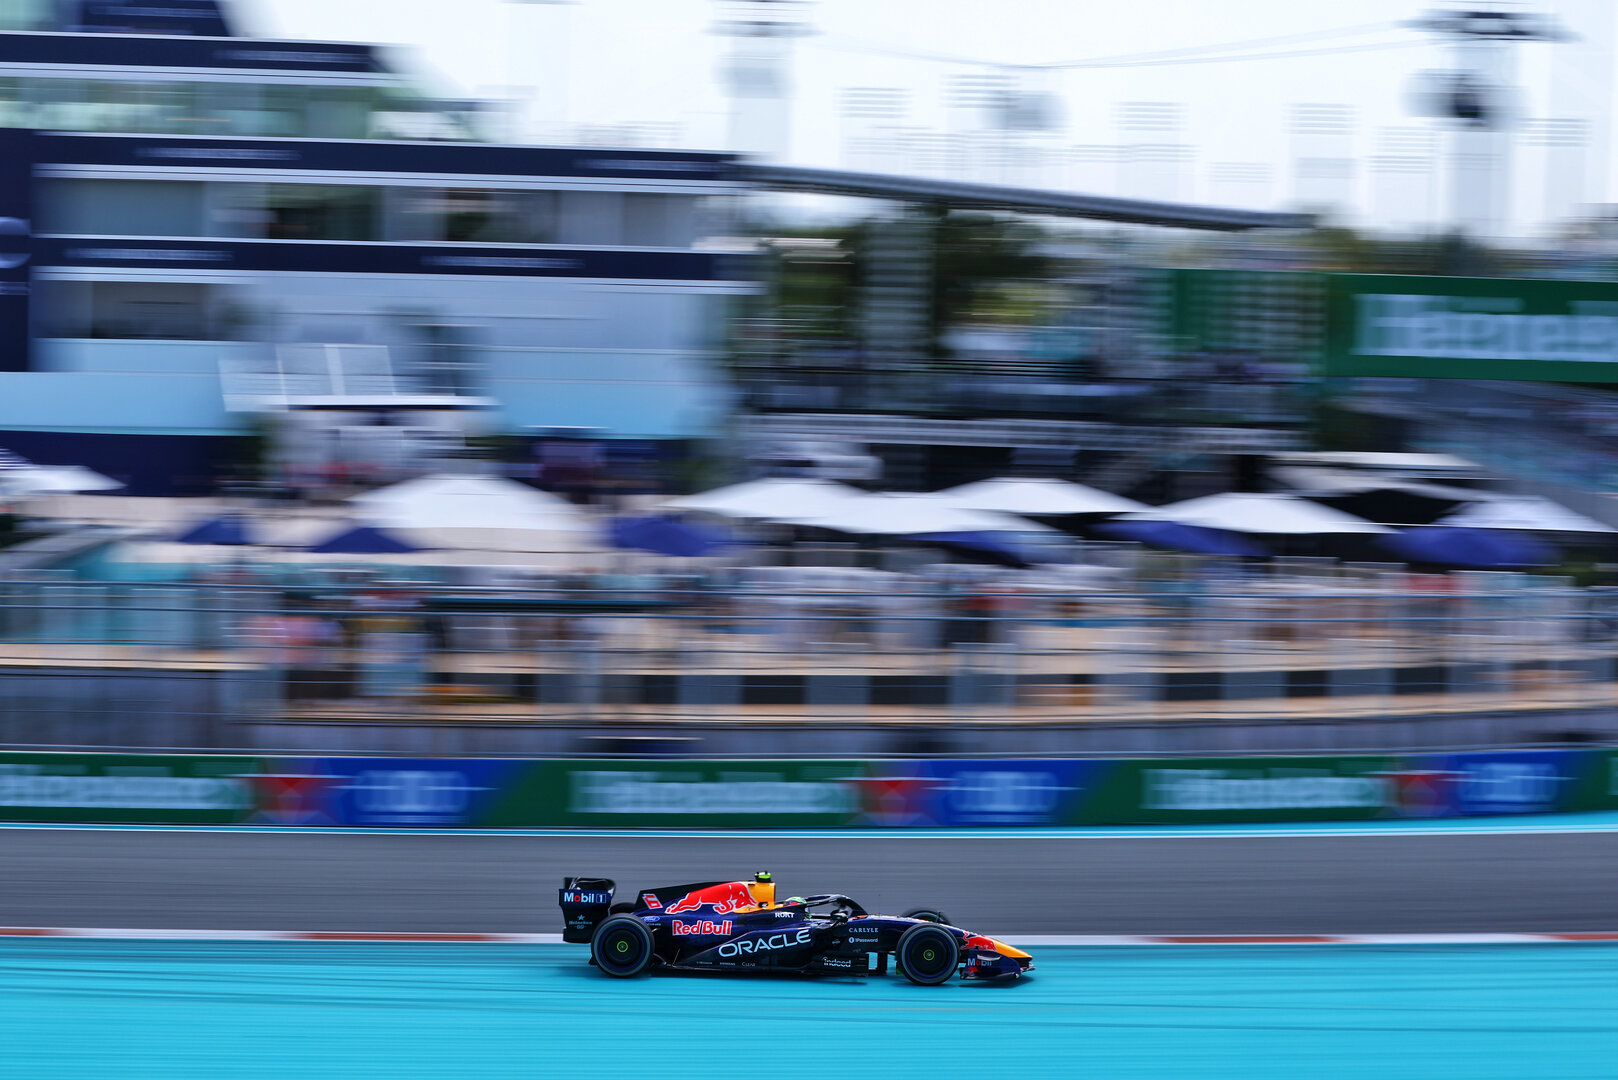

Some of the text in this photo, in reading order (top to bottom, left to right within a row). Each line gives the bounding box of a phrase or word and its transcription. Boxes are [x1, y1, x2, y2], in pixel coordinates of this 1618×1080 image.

[564, 892, 605, 903] Mobil 1
[642, 893, 663, 909] 6
[672, 920, 733, 936] Red Bull
[718, 929, 812, 957] ORACLE
